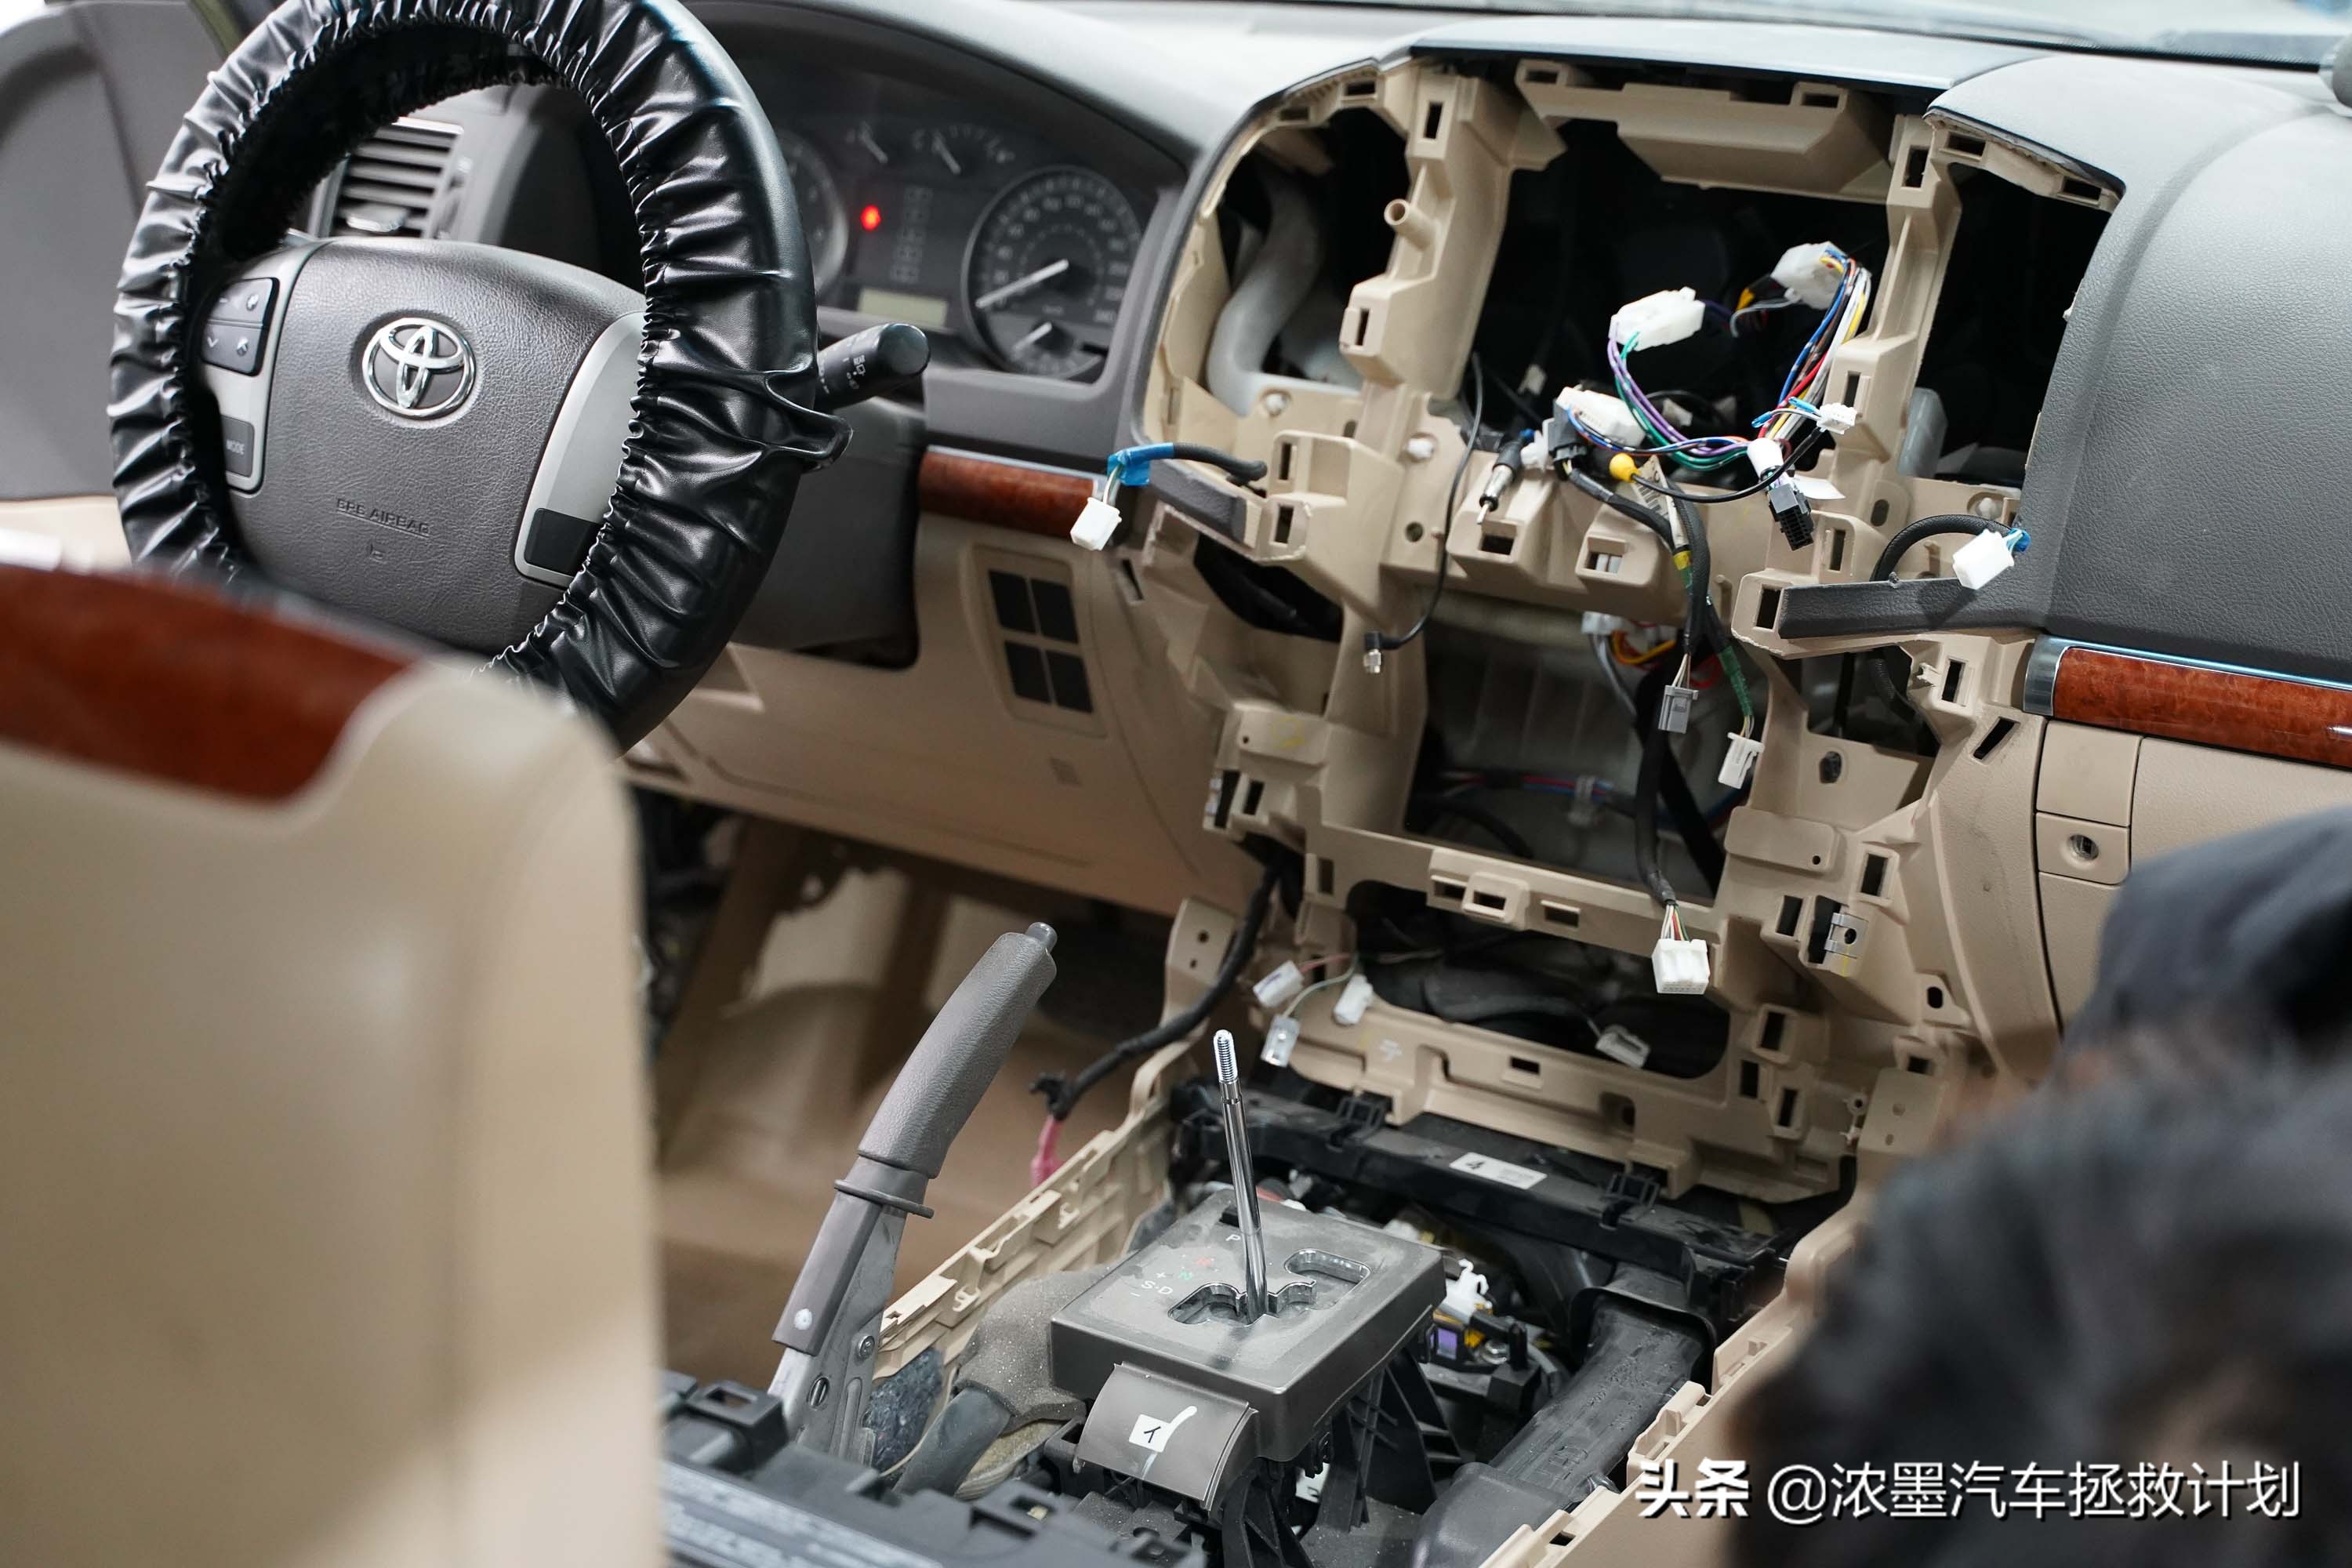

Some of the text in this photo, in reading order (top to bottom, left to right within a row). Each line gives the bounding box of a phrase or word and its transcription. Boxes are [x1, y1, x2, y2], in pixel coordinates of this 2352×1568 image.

[226, 439, 245, 456] MODE
[370, 508, 430, 535] AIRBAG
[1225, 1233, 1242, 1242] P
